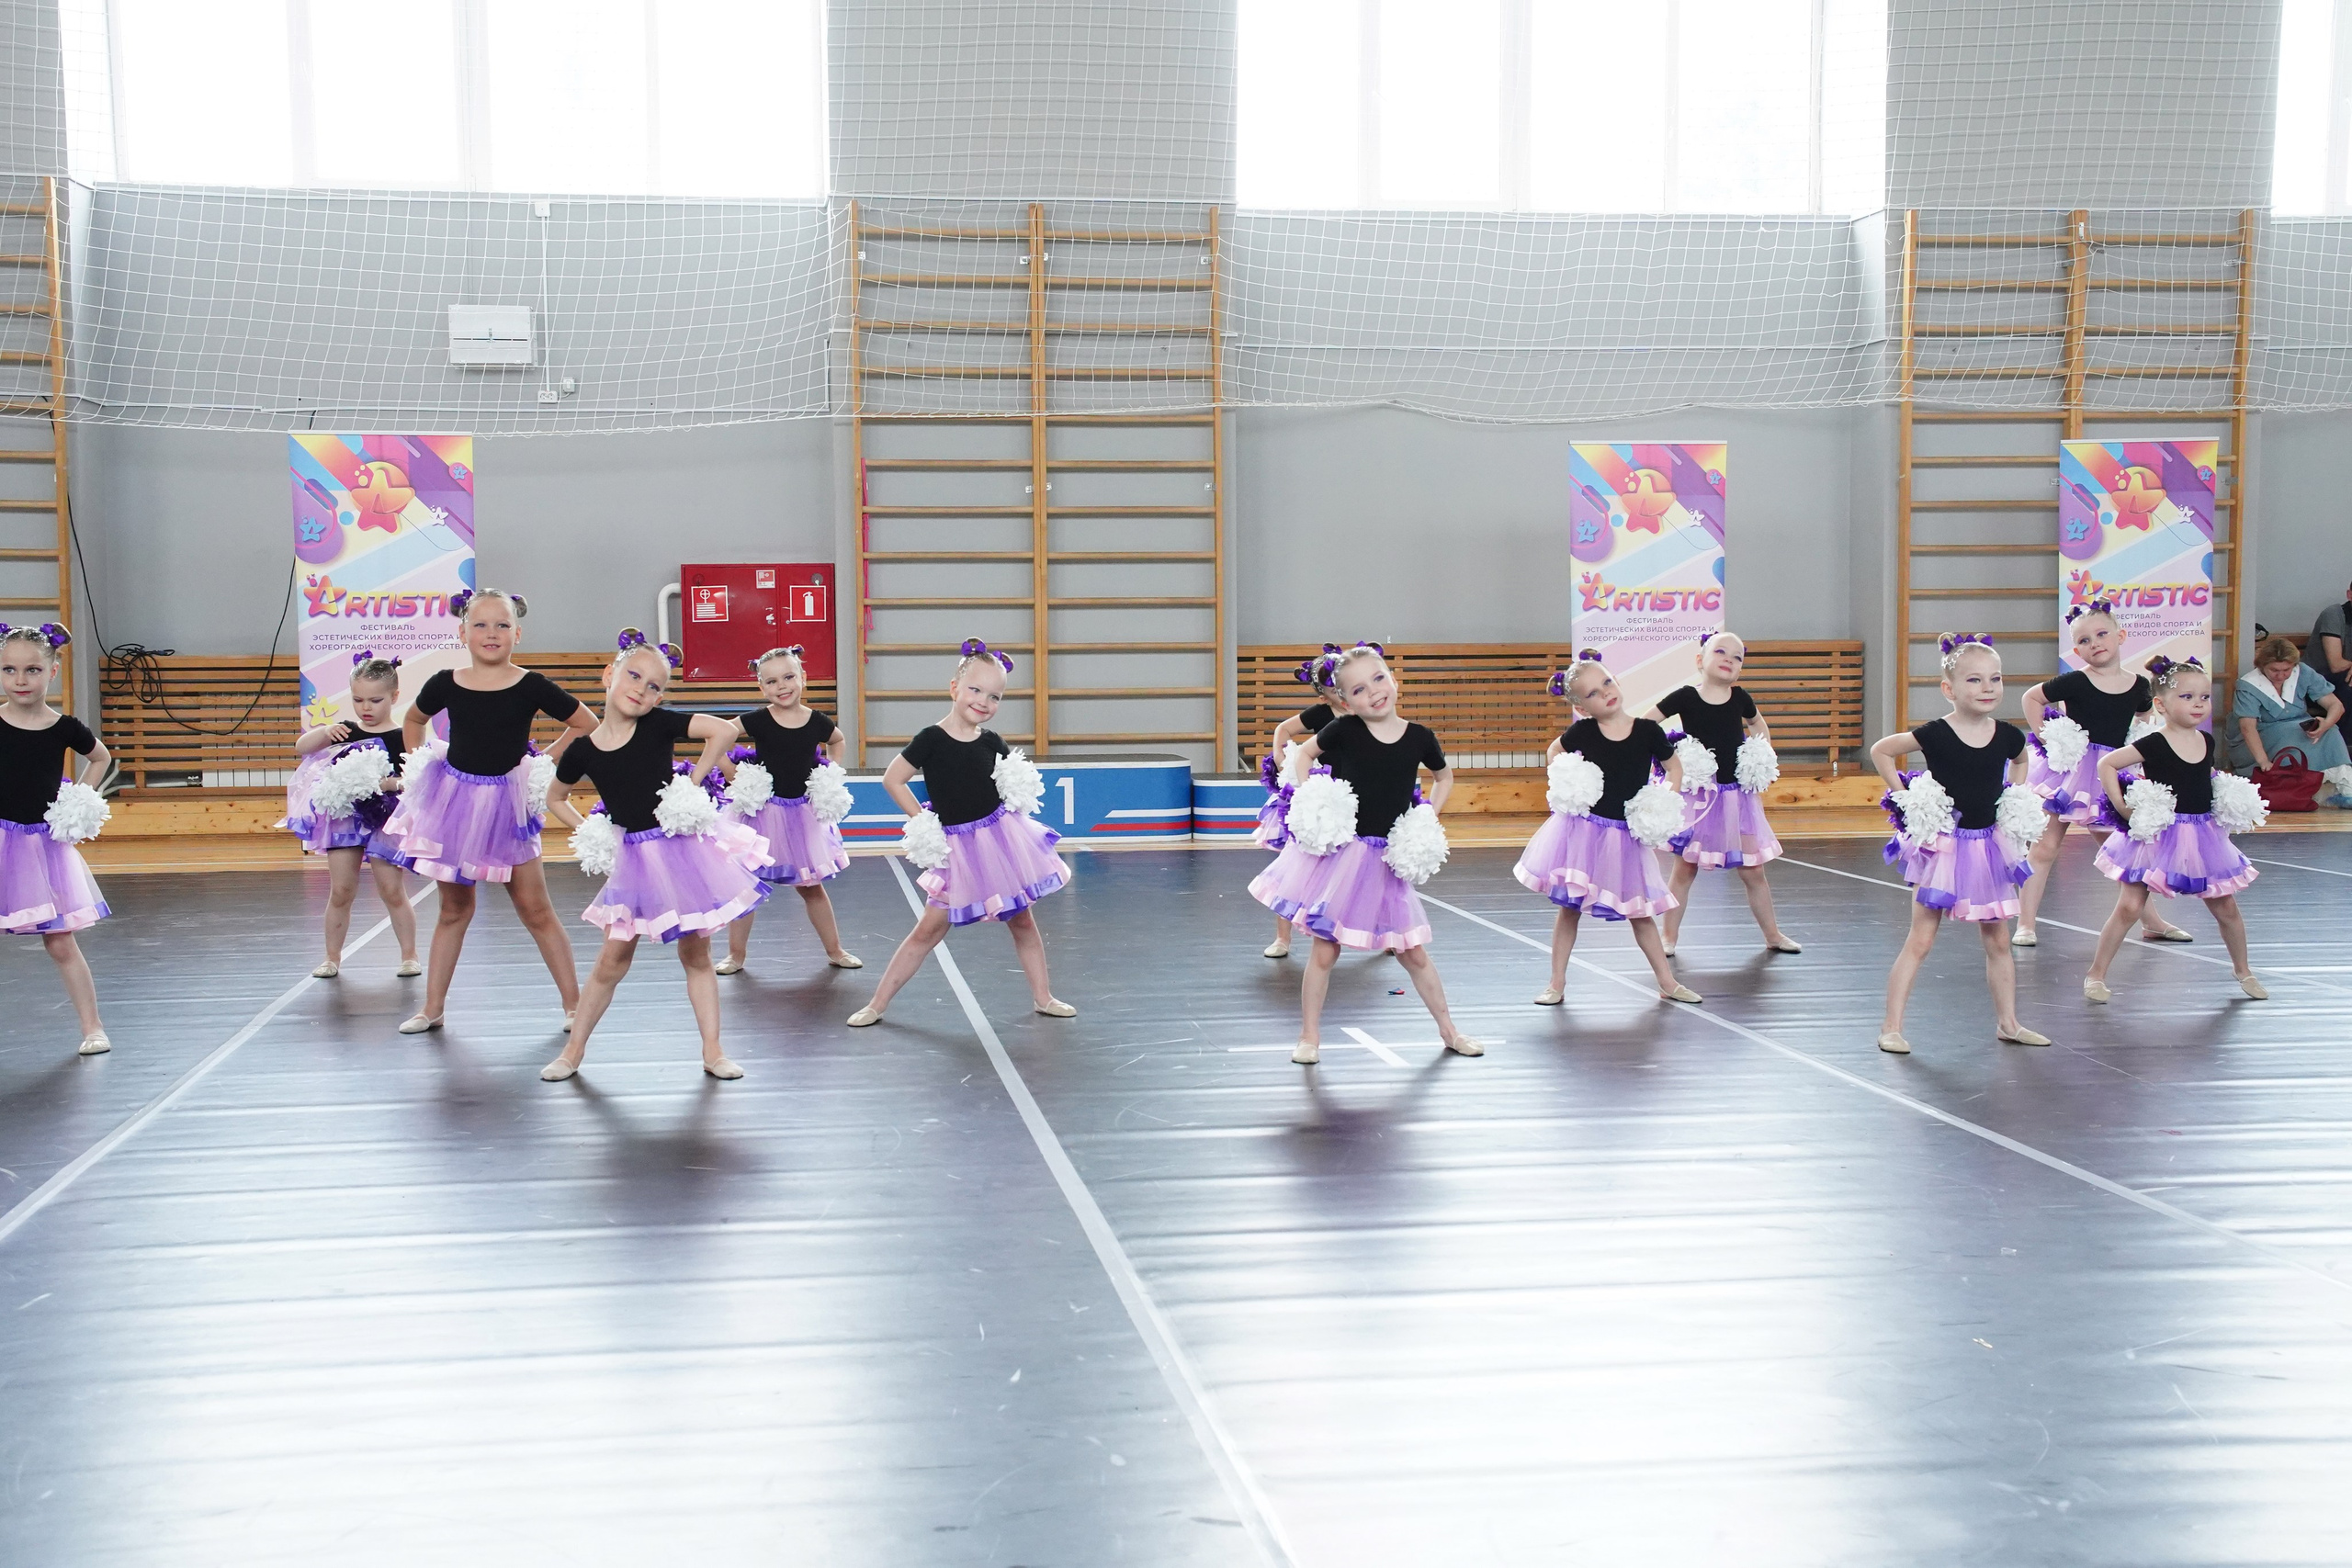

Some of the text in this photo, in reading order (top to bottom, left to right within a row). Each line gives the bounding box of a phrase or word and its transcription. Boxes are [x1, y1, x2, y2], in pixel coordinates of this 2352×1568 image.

[303, 575, 451, 617] ARTISTI
[1578, 572, 1721, 612] ARTISTIC
[2067, 570, 2209, 607] ARTISTIC
[310, 643, 413, 651] ХОРЕОГРАФИЧЕСКОГО
[1055, 777, 1074, 824] 1
